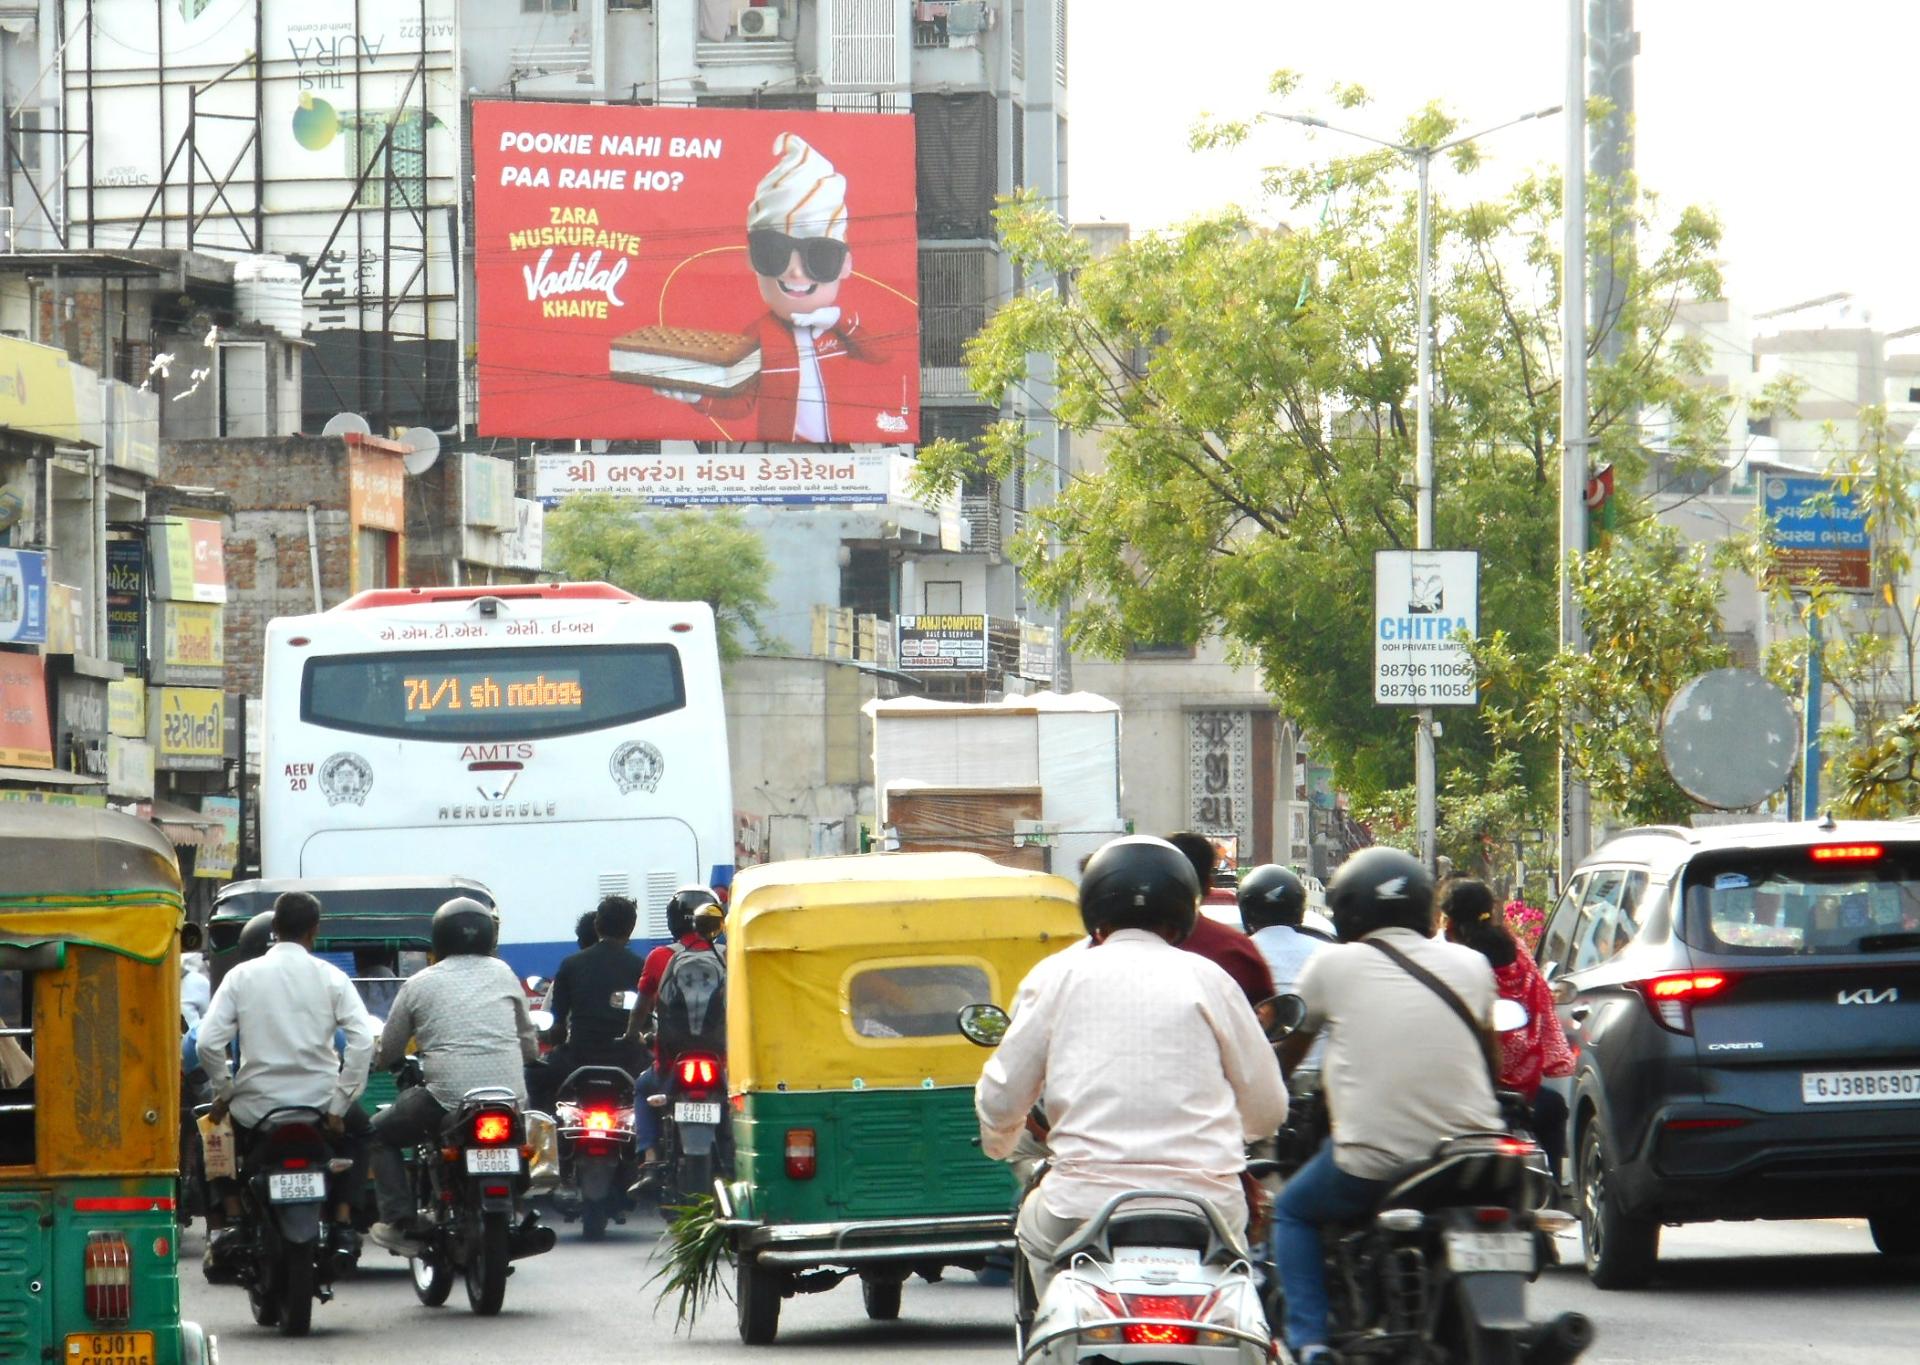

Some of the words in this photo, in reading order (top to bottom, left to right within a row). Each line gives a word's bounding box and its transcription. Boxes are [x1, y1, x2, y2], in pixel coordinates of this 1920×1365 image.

[287, 34, 384, 68] AURA
[298, 69, 344, 90] TULSI
[500, 130, 593, 156] POOKIE
[600, 136, 661, 158] NAHI
[668, 137, 722, 159] BAN
[500, 166, 550, 188] PAA
[558, 168, 626, 190] RAHE
[633, 170, 685, 192] HO?
[550, 206, 599, 226] ZARA
[509, 226, 641, 256] MUSKURAIYE
[523, 249, 628, 307] Vadilal
[542, 300, 608, 319] KHAIYE
[567, 460, 595, 482] શ્રી
[607, 460, 684, 482] બજરંગ
[697, 460, 745, 481] મંડપ
[757, 457, 856, 480] ડેકોરેશન
[108, 611, 138, 622] HOUSE
[941, 615, 983, 631] COMPUTER
[1402, 643, 1437, 651] PRIVATE
[1438, 643, 1468, 651] LIMITE
[1380, 663, 1427, 677] 98796
[403, 677, 462, 710] 71/1
[1380, 684, 1427, 697] 98796
[1430, 684, 1471, 697] 11058
[164, 695, 220, 750] સ્ટેશનરી
[460, 743, 534, 761] AMTS
[284, 763, 315, 778] AEEV
[290, 778, 308, 792] 20
[93, 1336, 135, 1355] GJ01
